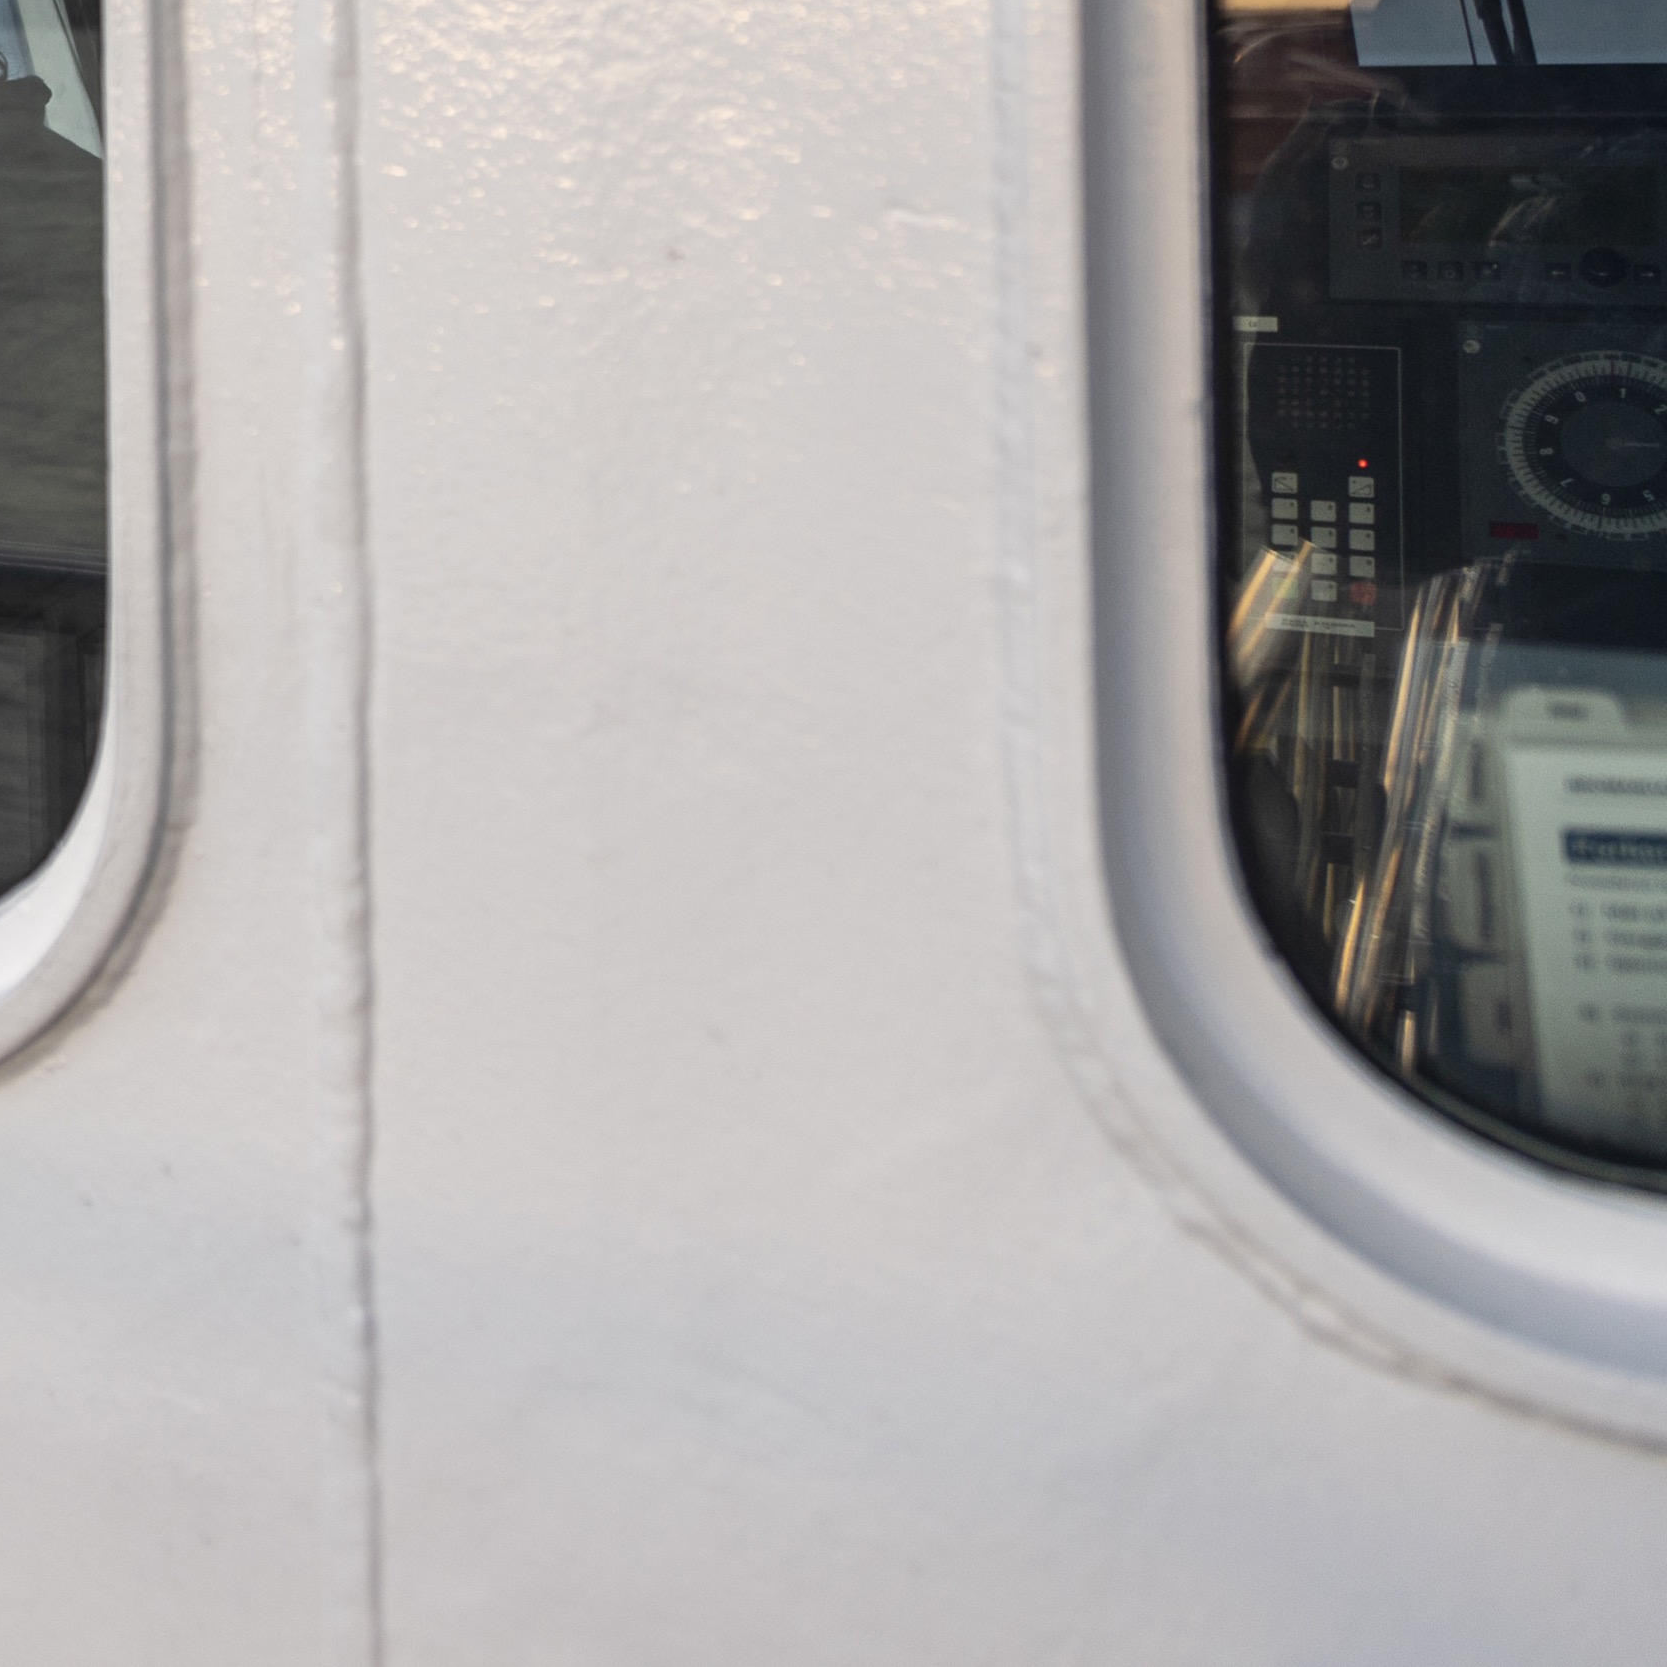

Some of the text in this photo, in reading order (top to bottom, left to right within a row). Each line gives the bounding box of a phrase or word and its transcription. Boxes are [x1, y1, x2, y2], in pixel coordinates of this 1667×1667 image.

[1574, 391, 1587, 403] 0
[1619, 388, 1627, 399] 1
[1539, 447, 1554, 456] 8
